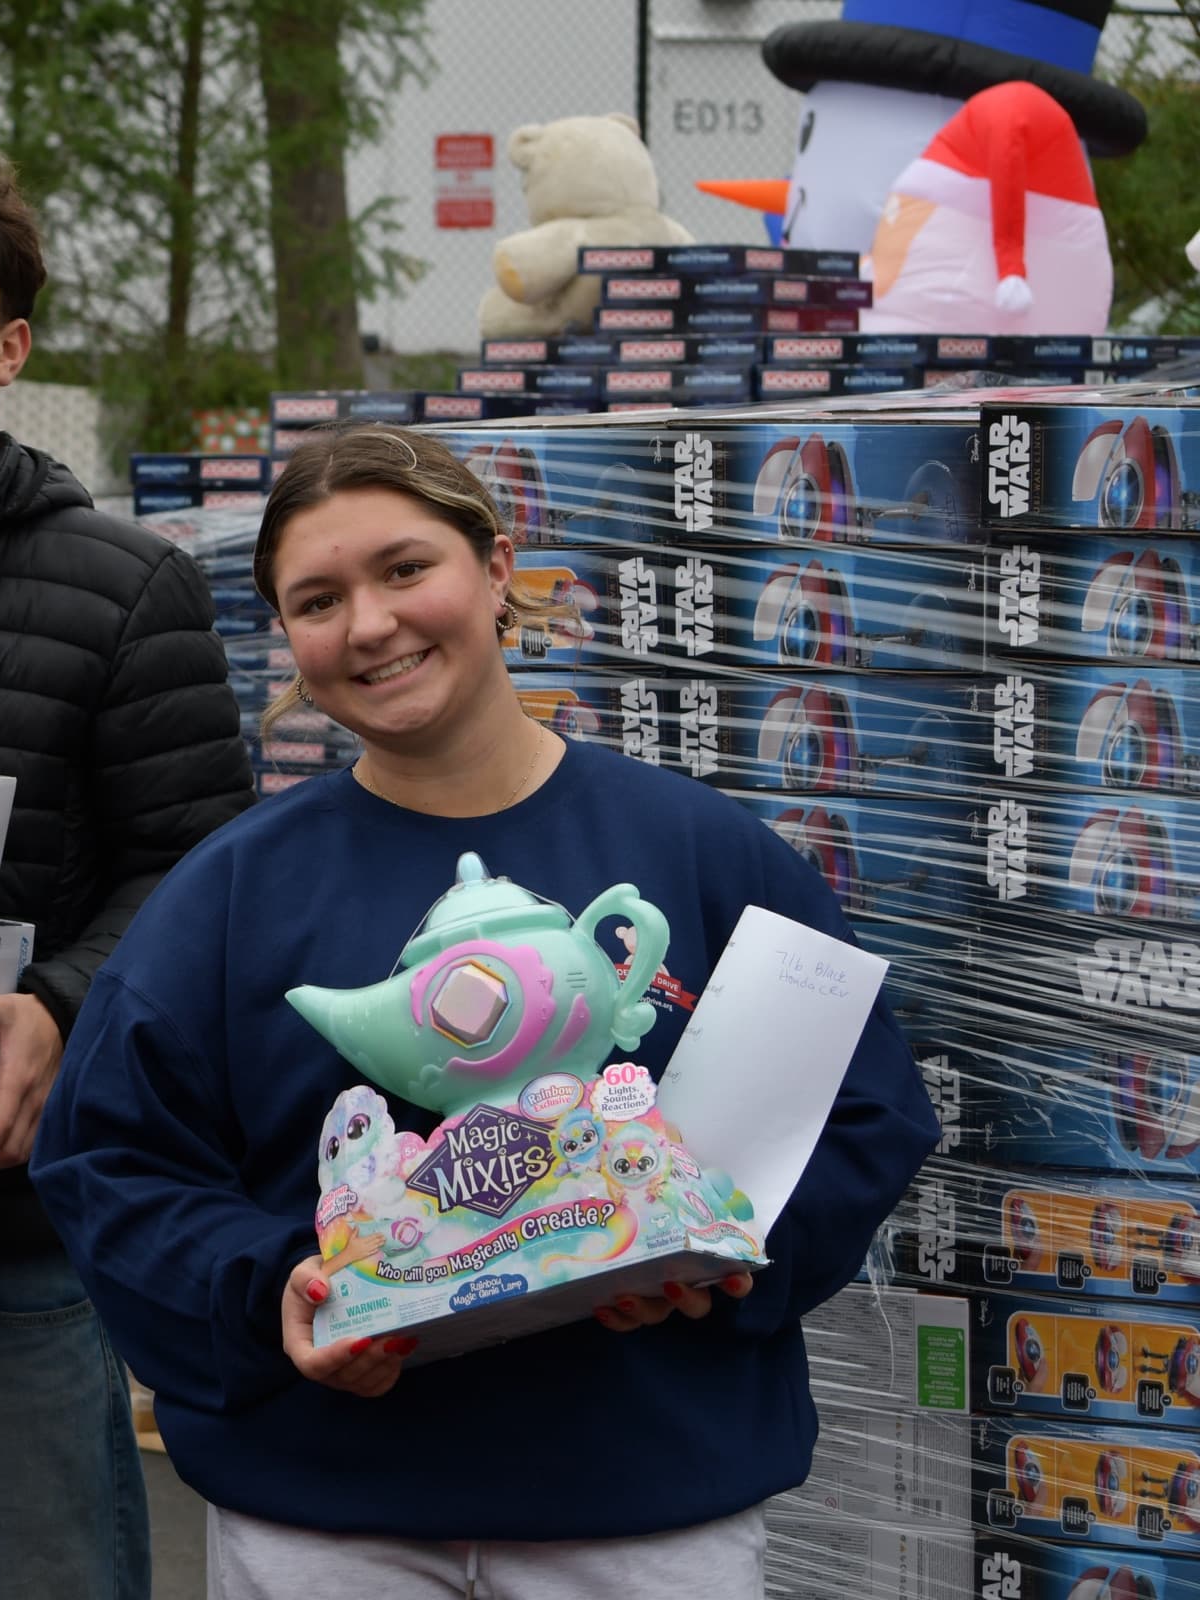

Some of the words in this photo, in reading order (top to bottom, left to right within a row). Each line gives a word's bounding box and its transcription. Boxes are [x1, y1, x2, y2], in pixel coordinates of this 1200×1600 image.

[764, 373, 828, 389] MONOPOLY
[776, 341, 841, 357] MONOPOLY
[674, 433, 694, 531] STAR
[694, 433, 714, 531] WARS
[988, 416, 1010, 517] STAR
[1009, 416, 1030, 517] WARS
[618, 557, 638, 655] WARS
[638, 557, 658, 655] STAR
[675, 558, 695, 656] STAR
[695, 558, 714, 656] WARS
[999, 545, 1020, 646] STAR
[1019, 545, 1041, 646] WARS
[620, 680, 641, 758] WAR
[680, 680, 699, 777] STAR
[699, 680, 718, 777] WARS
[993, 676, 1014, 777] STAR
[1014, 676, 1035, 777] WARS
[987, 800, 1008, 900] STAR
[1007, 800, 1028, 900] WARS
[815, 961, 848, 984] Black
[527, 1085, 576, 1105] Rainbow
[533, 1096, 571, 1113] Exclusive
[601, 1098, 648, 1112] Reactions!
[603, 1094, 638, 1104] Sounds
[605, 1065, 647, 1086] 60+
[446, 1117, 522, 1159] Magic
[376, 1262, 401, 1280] Who
[403, 1268, 423, 1282] will
[426, 1266, 447, 1283] you
[449, 1231, 519, 1271] Magically
[520, 1202, 616, 1240] Create?
[918, 1181, 937, 1282] WARS
[937, 1181, 956, 1282] STAR
[346, 1297, 392, 1318] WARNING:
[453, 1291, 478, 1306] Magic
[500, 1279, 523, 1293] Lamp
[470, 1277, 502, 1293] Rainbow
[982, 1552, 1002, 1600] AR
[1002, 1552, 1022, 1600] RS
